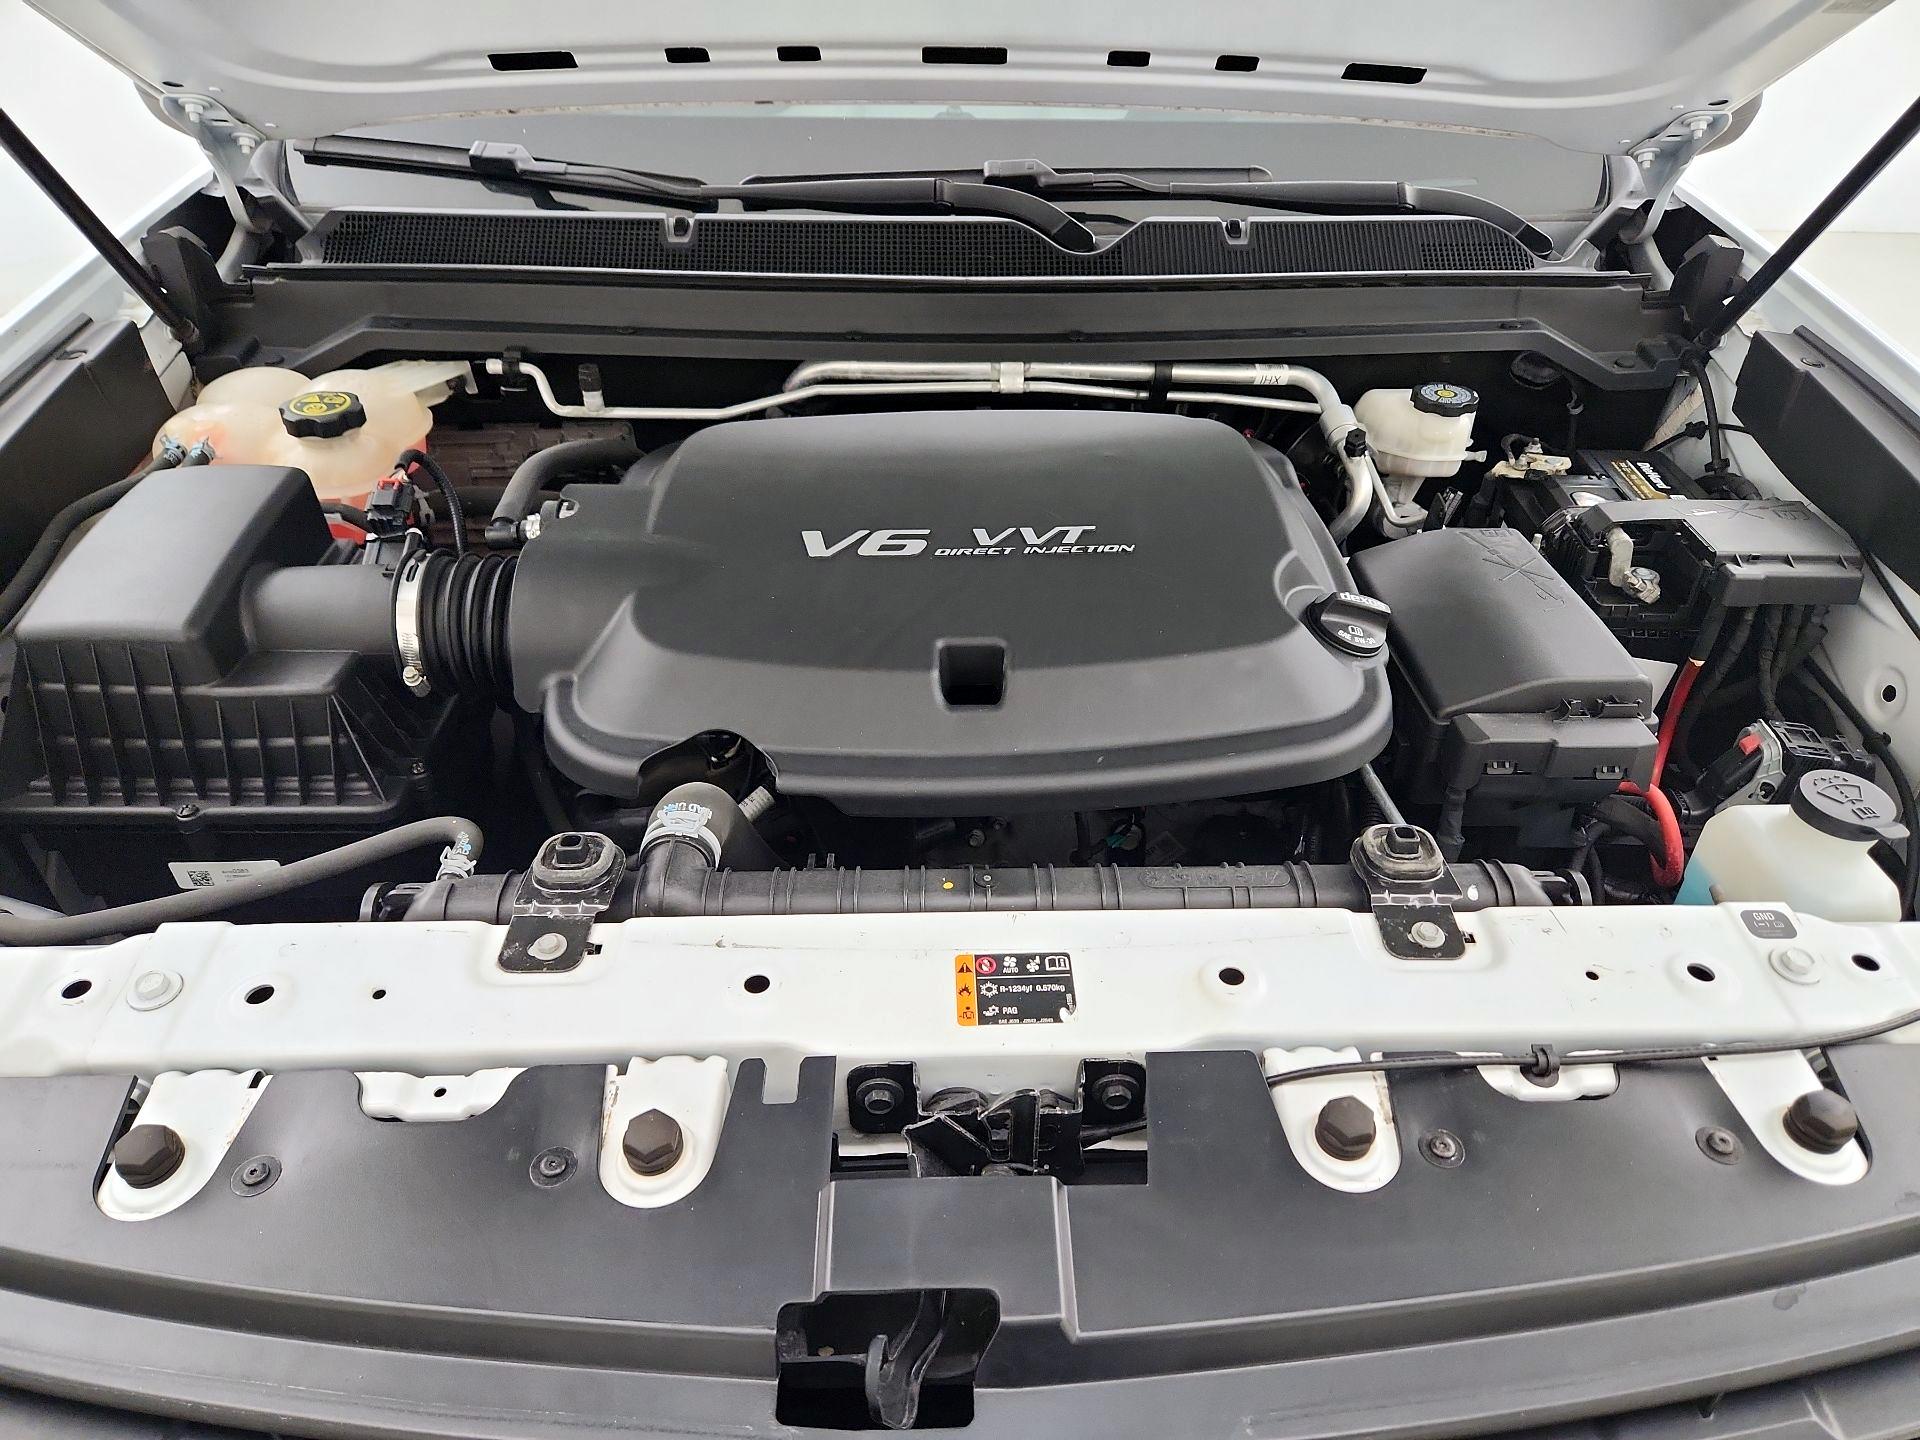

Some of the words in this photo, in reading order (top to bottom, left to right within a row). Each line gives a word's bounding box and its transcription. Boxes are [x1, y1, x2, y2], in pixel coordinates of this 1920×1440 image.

[801, 529, 931, 557] V6
[971, 525, 1096, 546] VVT
[934, 546, 1016, 557] DIRECT
[1022, 543, 1136, 555] INJECTION
[1752, 912, 1775, 921] GND
[1002, 1006, 1018, 1015] PAG
